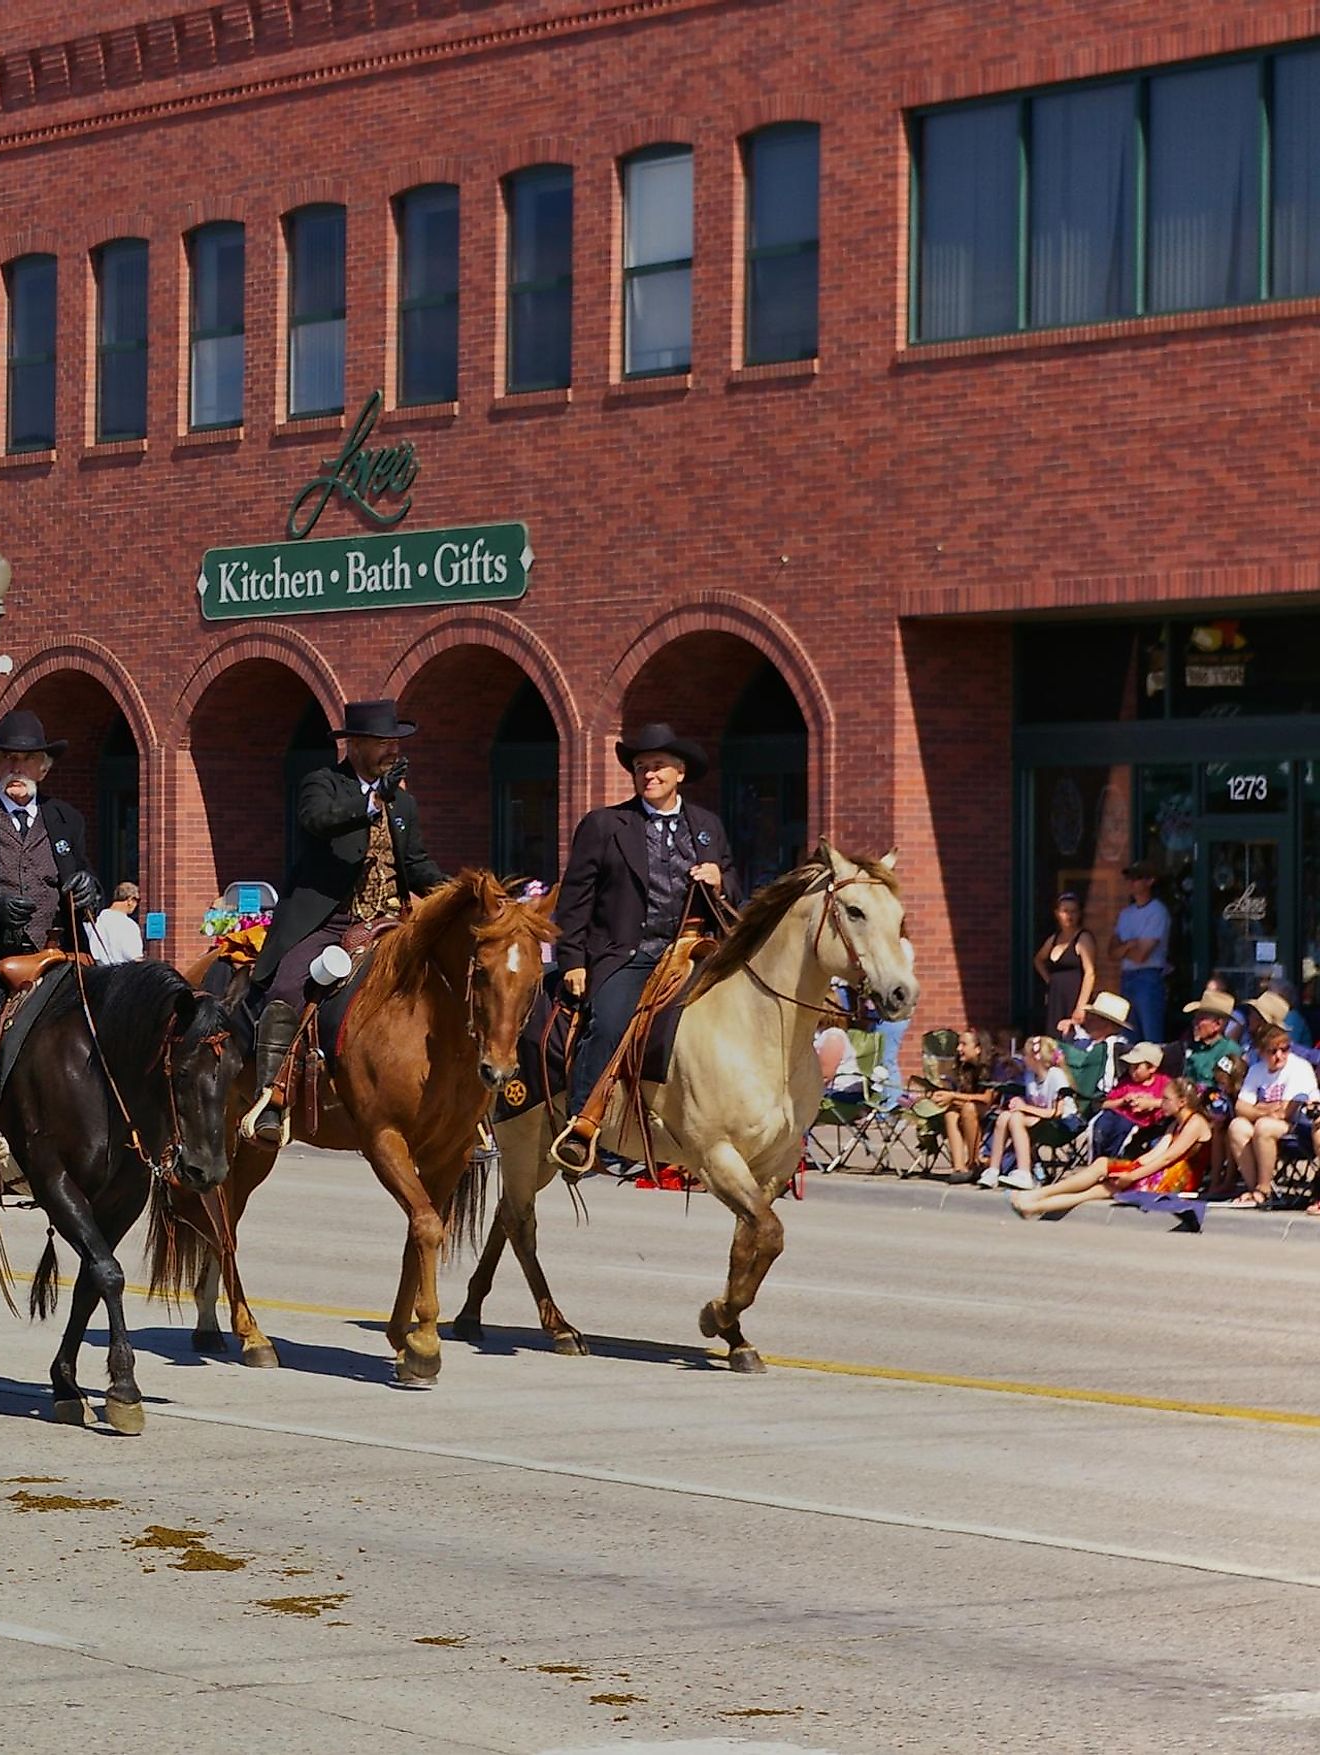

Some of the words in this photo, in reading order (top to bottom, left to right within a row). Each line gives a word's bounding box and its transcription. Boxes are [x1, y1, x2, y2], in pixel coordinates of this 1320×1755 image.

[218, 556, 324, 604] Kitchen
[346, 546, 412, 594] Bath
[434, 538, 508, 587] Gifts
[1226, 775, 1268, 801] 1273
